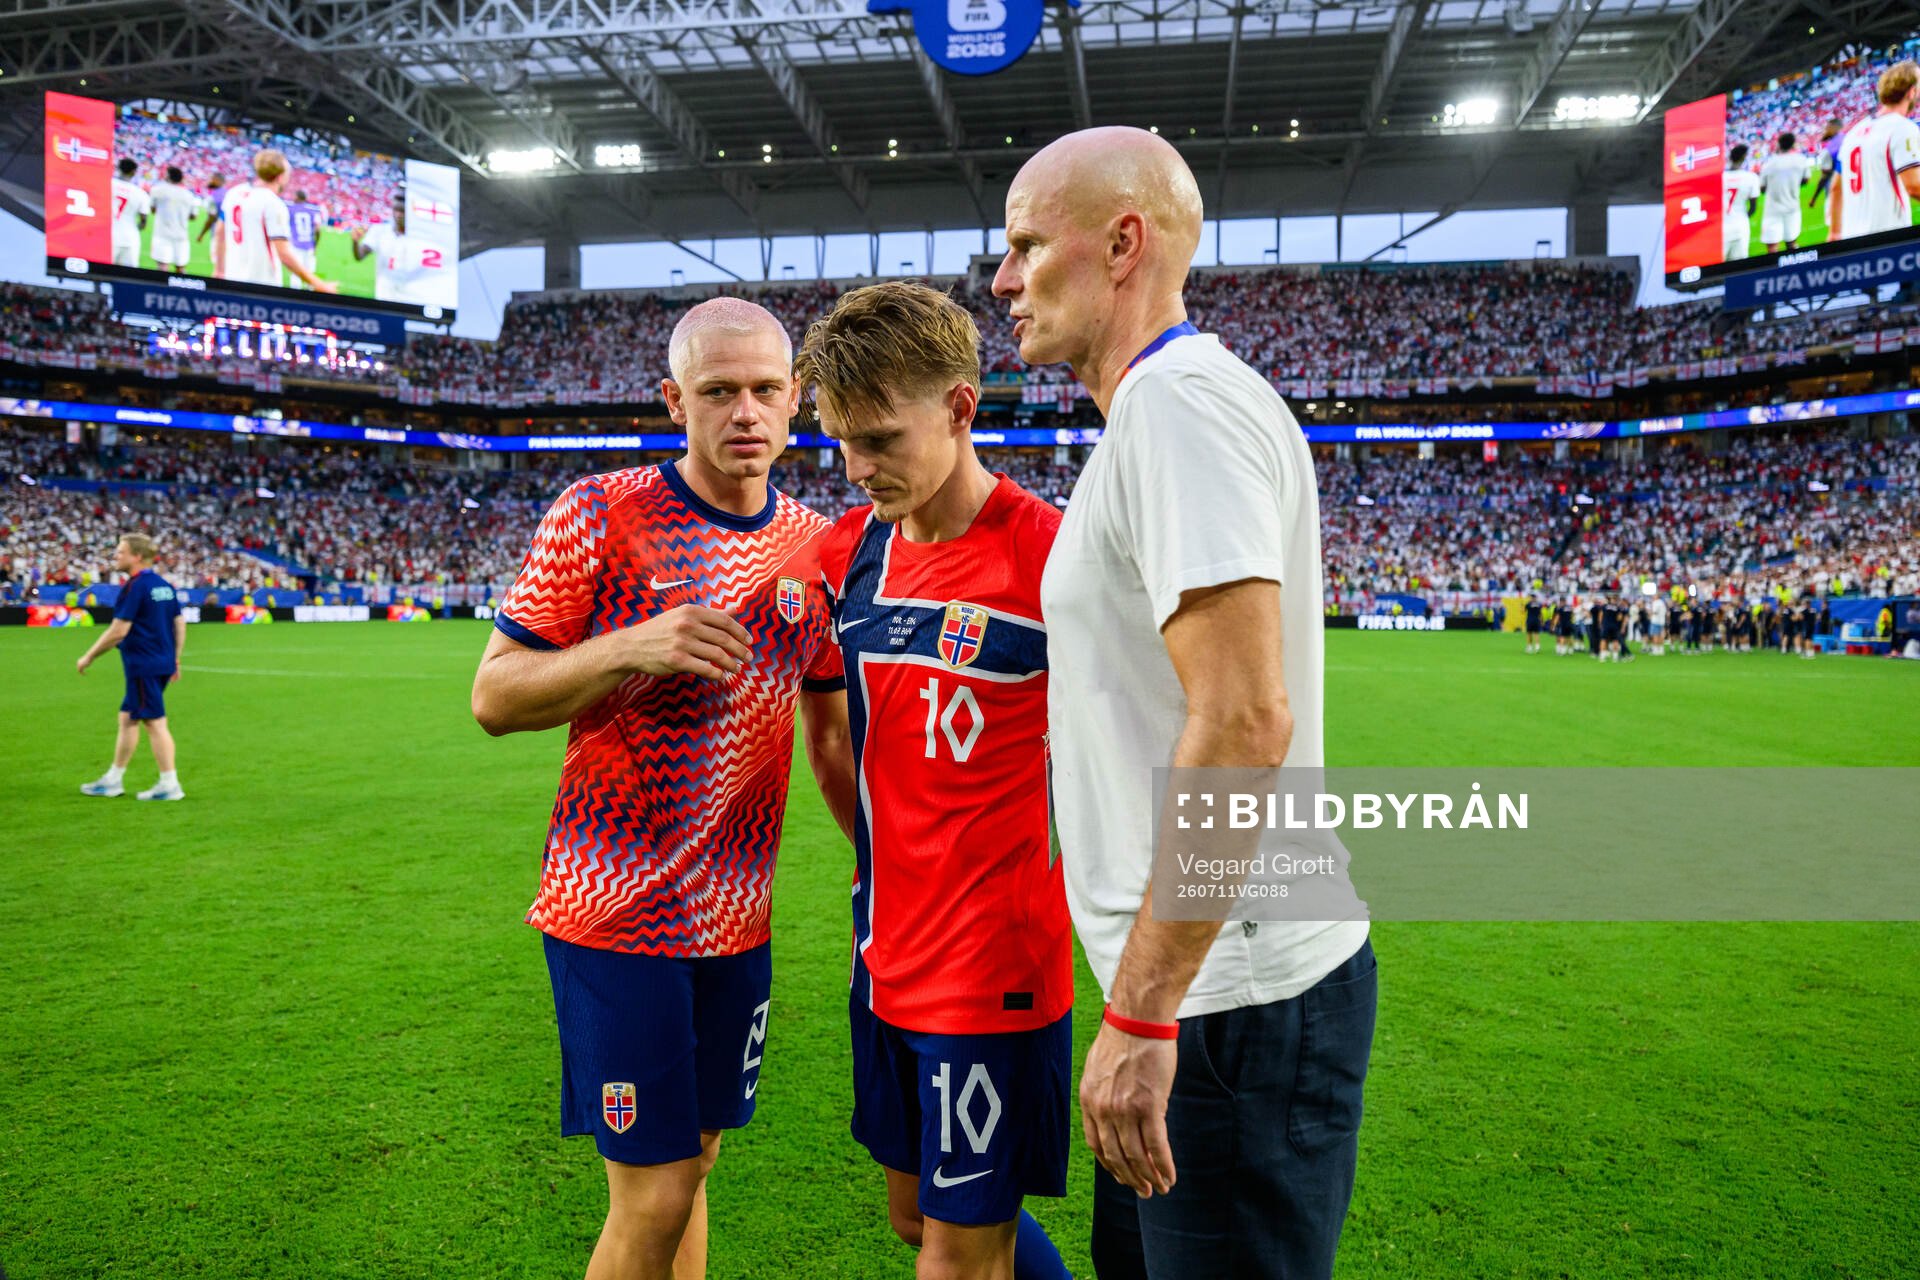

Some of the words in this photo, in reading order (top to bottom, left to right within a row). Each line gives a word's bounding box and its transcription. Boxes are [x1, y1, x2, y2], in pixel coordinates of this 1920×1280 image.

[965, 13, 990, 22] FIFA
[947, 42, 1006, 58] 2026
[948, 33, 984, 43] WORLD
[985, 32, 1006, 42] CUP
[1849, 146, 1863, 194] 9
[66, 188, 95, 217] 1
[1681, 196, 1707, 225] 1
[421, 249, 442, 269] 2
[1755, 273, 1803, 297] FIFA
[1806, 257, 1894, 288] WORLD
[144, 292, 191, 313] FIFA
[193, 298, 268, 320] WORLD
[271, 308, 311, 324] CUP
[314, 313, 380, 335] 2026
[1358, 614, 1394, 630] FIFA
[920, 677, 984, 762] 10
[932, 1063, 1002, 1154] 10
